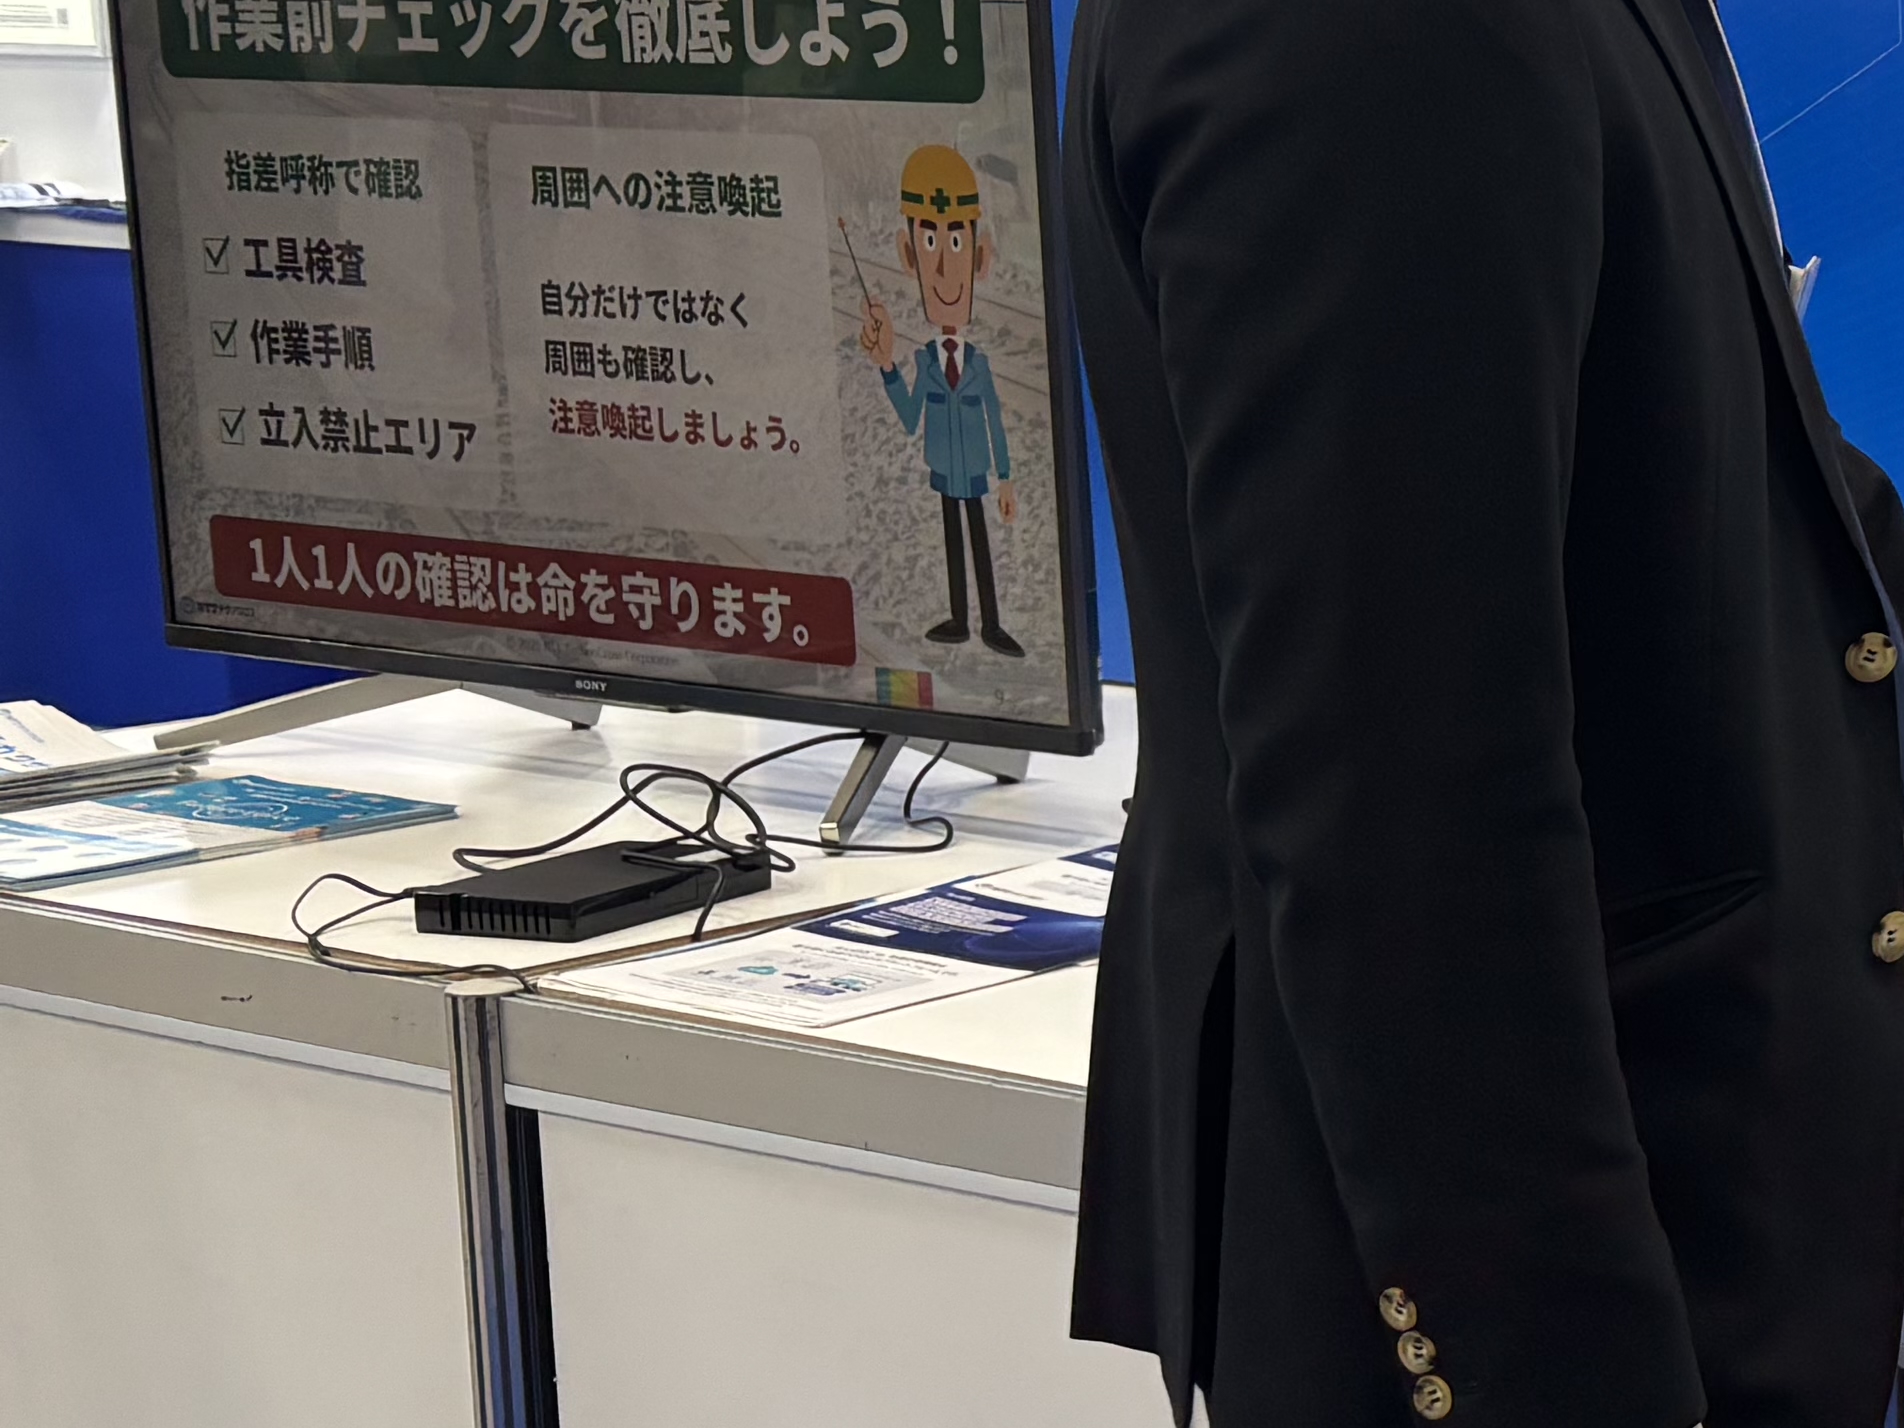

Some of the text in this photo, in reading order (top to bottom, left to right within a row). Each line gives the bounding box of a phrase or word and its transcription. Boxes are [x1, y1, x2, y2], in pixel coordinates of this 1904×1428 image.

[224, 149, 423, 202] 指差呼称で確認
[530, 164, 783, 220] 周囲への注意喚起
[244, 238, 368, 289] 工具検査
[540, 279, 750, 332] 自分だけではなく
[249, 317, 376, 372] 作業手順
[543, 339, 717, 389] 周囲も確認し、
[258, 403, 478, 464] 立入禁止エリア
[548, 397, 803, 458] 注意喚起しましょう。
[247, 534, 812, 649] 1人1人の確認は命を守ります。
[575, 679, 608, 693] SONY
